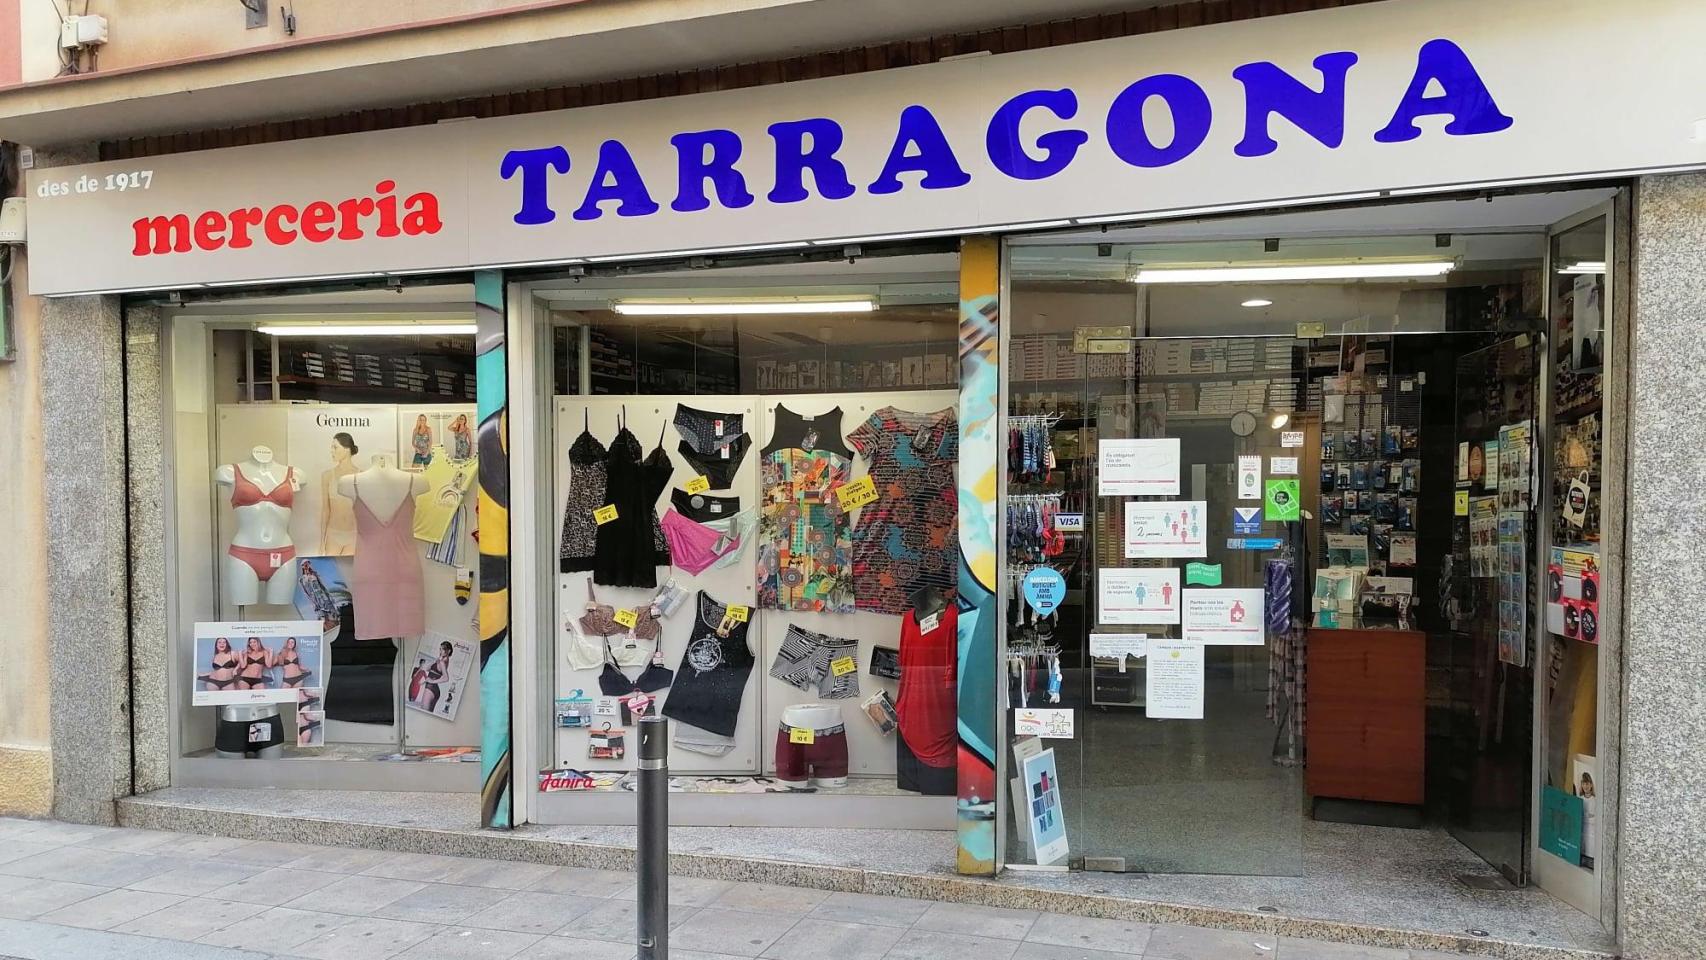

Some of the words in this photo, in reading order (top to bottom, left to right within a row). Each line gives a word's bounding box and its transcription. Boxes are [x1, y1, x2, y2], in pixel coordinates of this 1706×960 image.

[500, 38, 1514, 225] TARRAGONA
[37, 177, 69, 198] des
[75, 175, 98, 194] de
[104, 170, 153, 192] 1917
[131, 179, 443, 257] merceria
[316, 413, 370, 428] Gemma
[1059, 517, 1080, 526] VISA
[1137, 526, 1144, 537] 2
[538, 772, 597, 792] Janira
